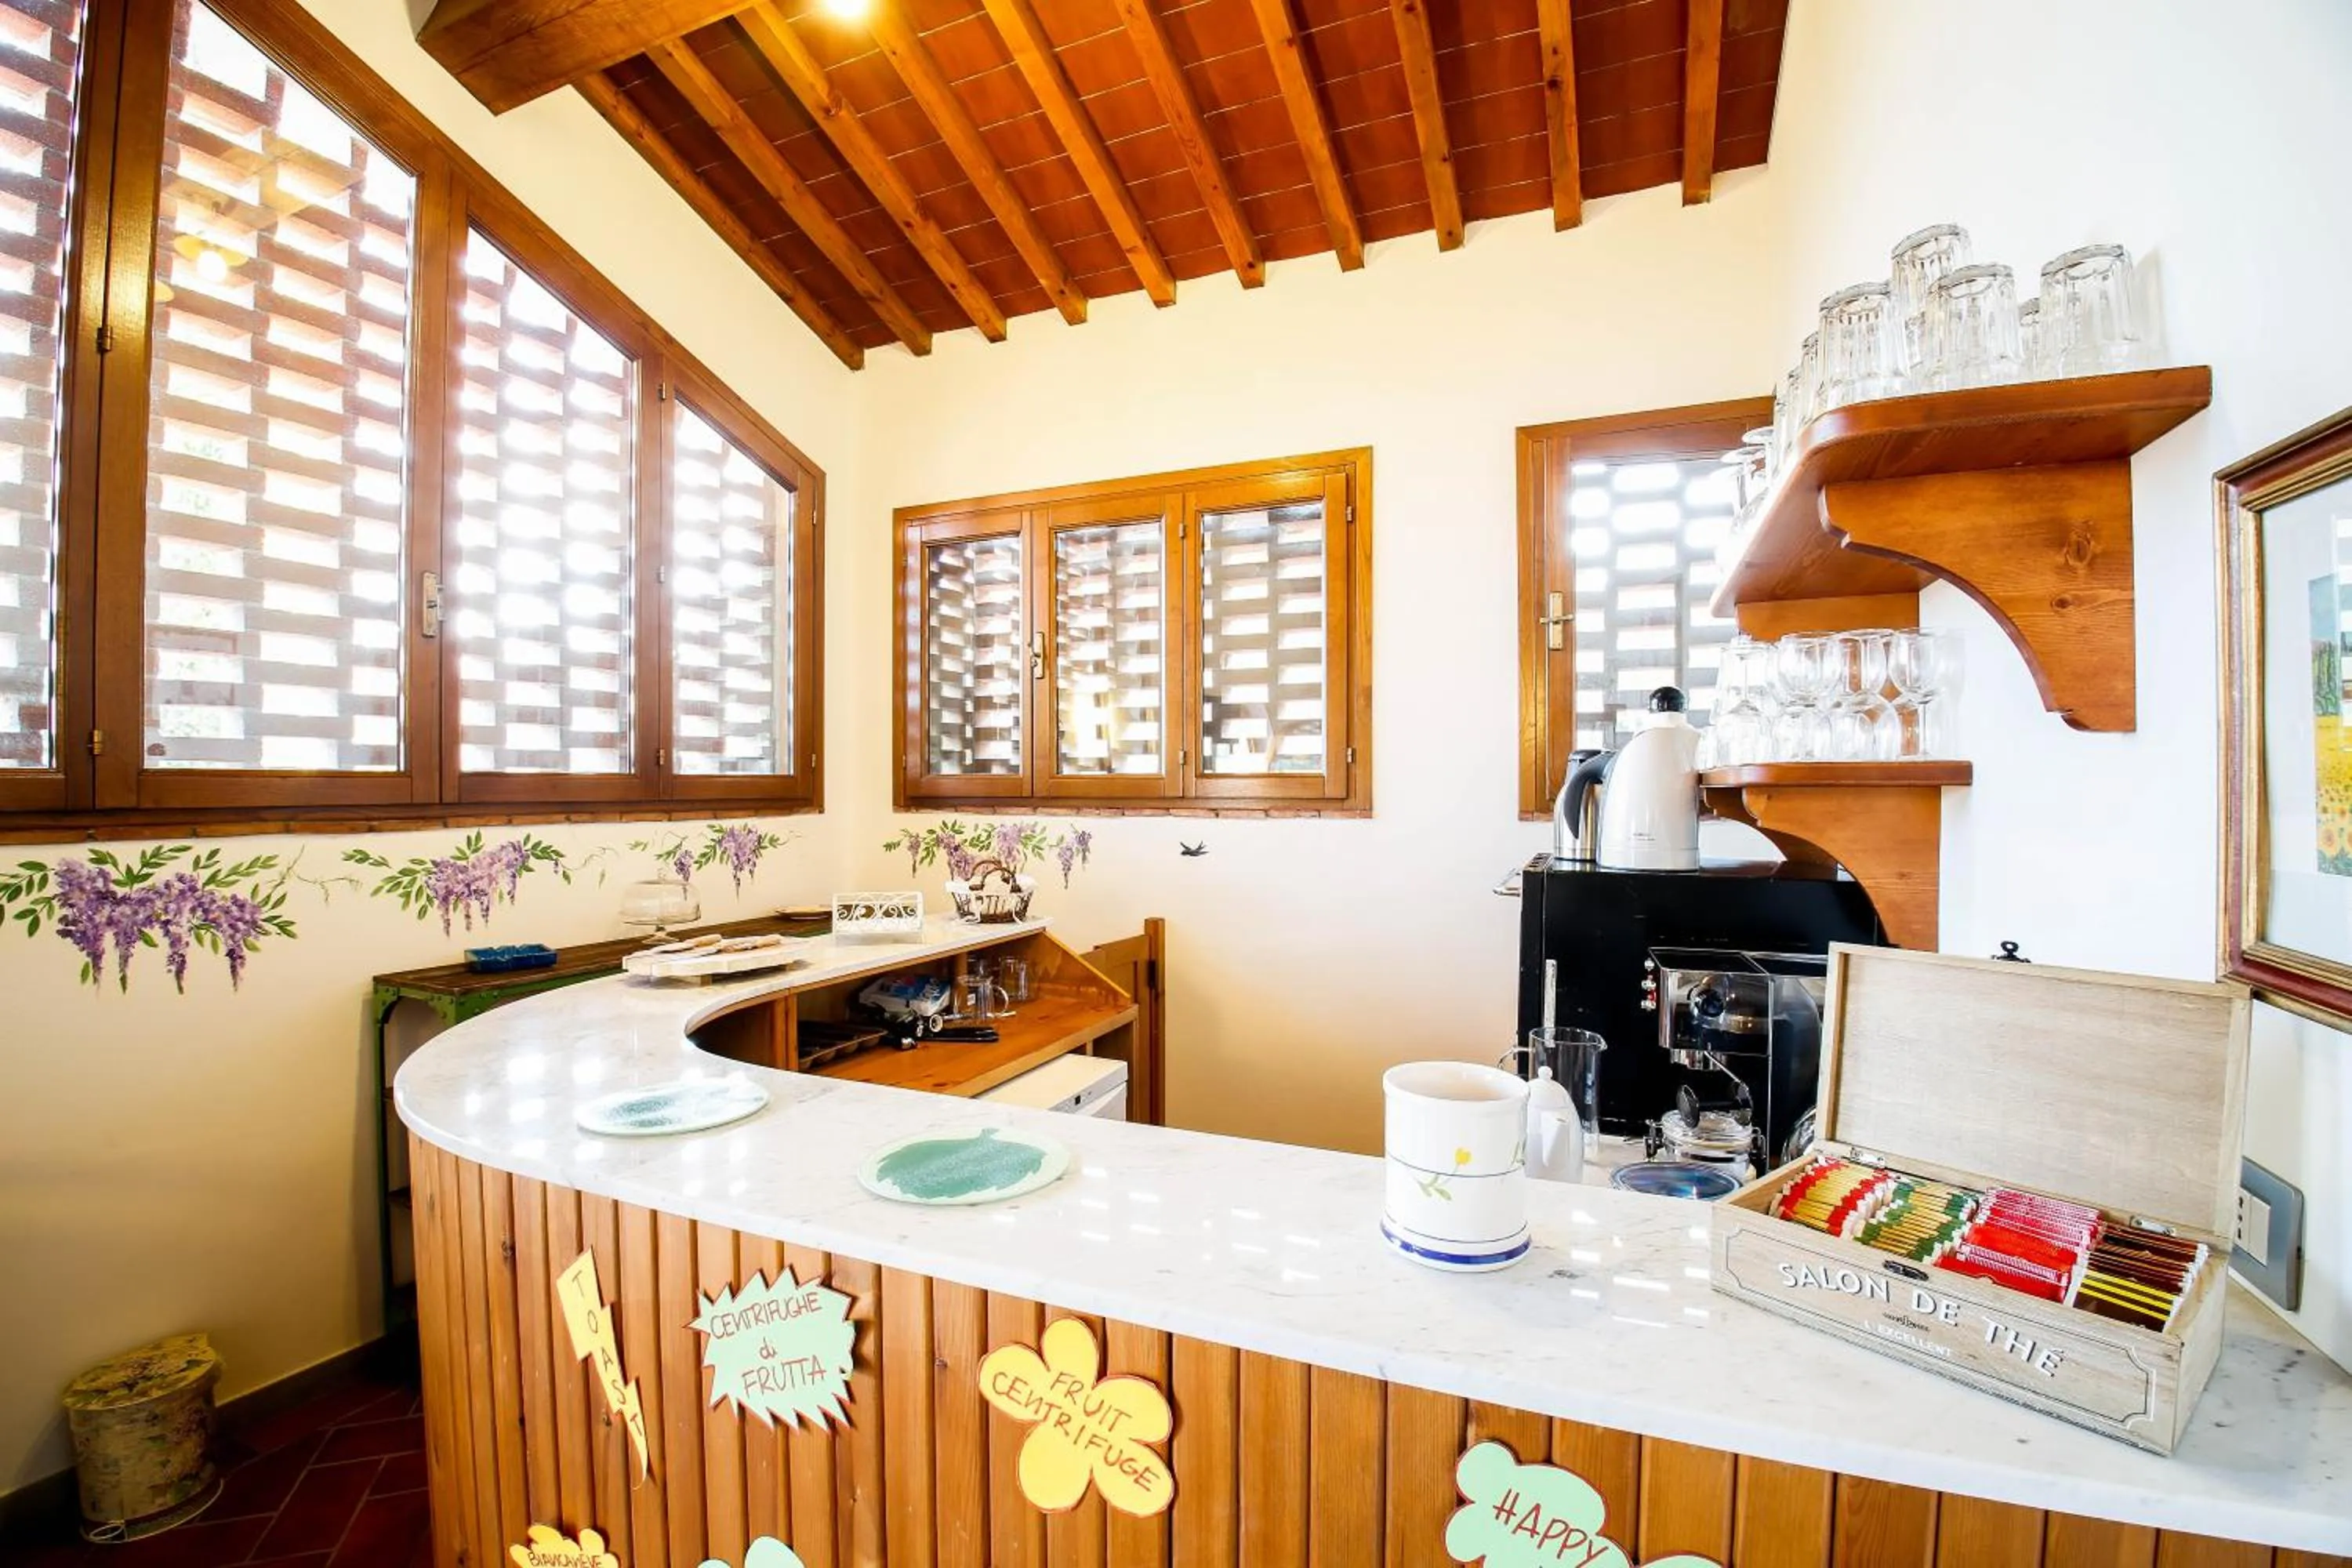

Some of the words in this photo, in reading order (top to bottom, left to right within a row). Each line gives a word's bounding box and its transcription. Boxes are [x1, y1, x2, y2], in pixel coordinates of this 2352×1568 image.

[710, 1291, 823, 1340] CENTRIFUGHE
[1779, 1262, 1890, 1303] SALON
[1911, 1289, 1960, 1327] DE
[572, 1270, 643, 1438] TOAST
[741, 1354, 828, 1399] FRUTTA
[992, 1371, 1161, 1492] CENTRIFUGE
[1050, 1371, 1133, 1433] FRUIT
[1492, 1489, 1609, 1568] HAPPY
